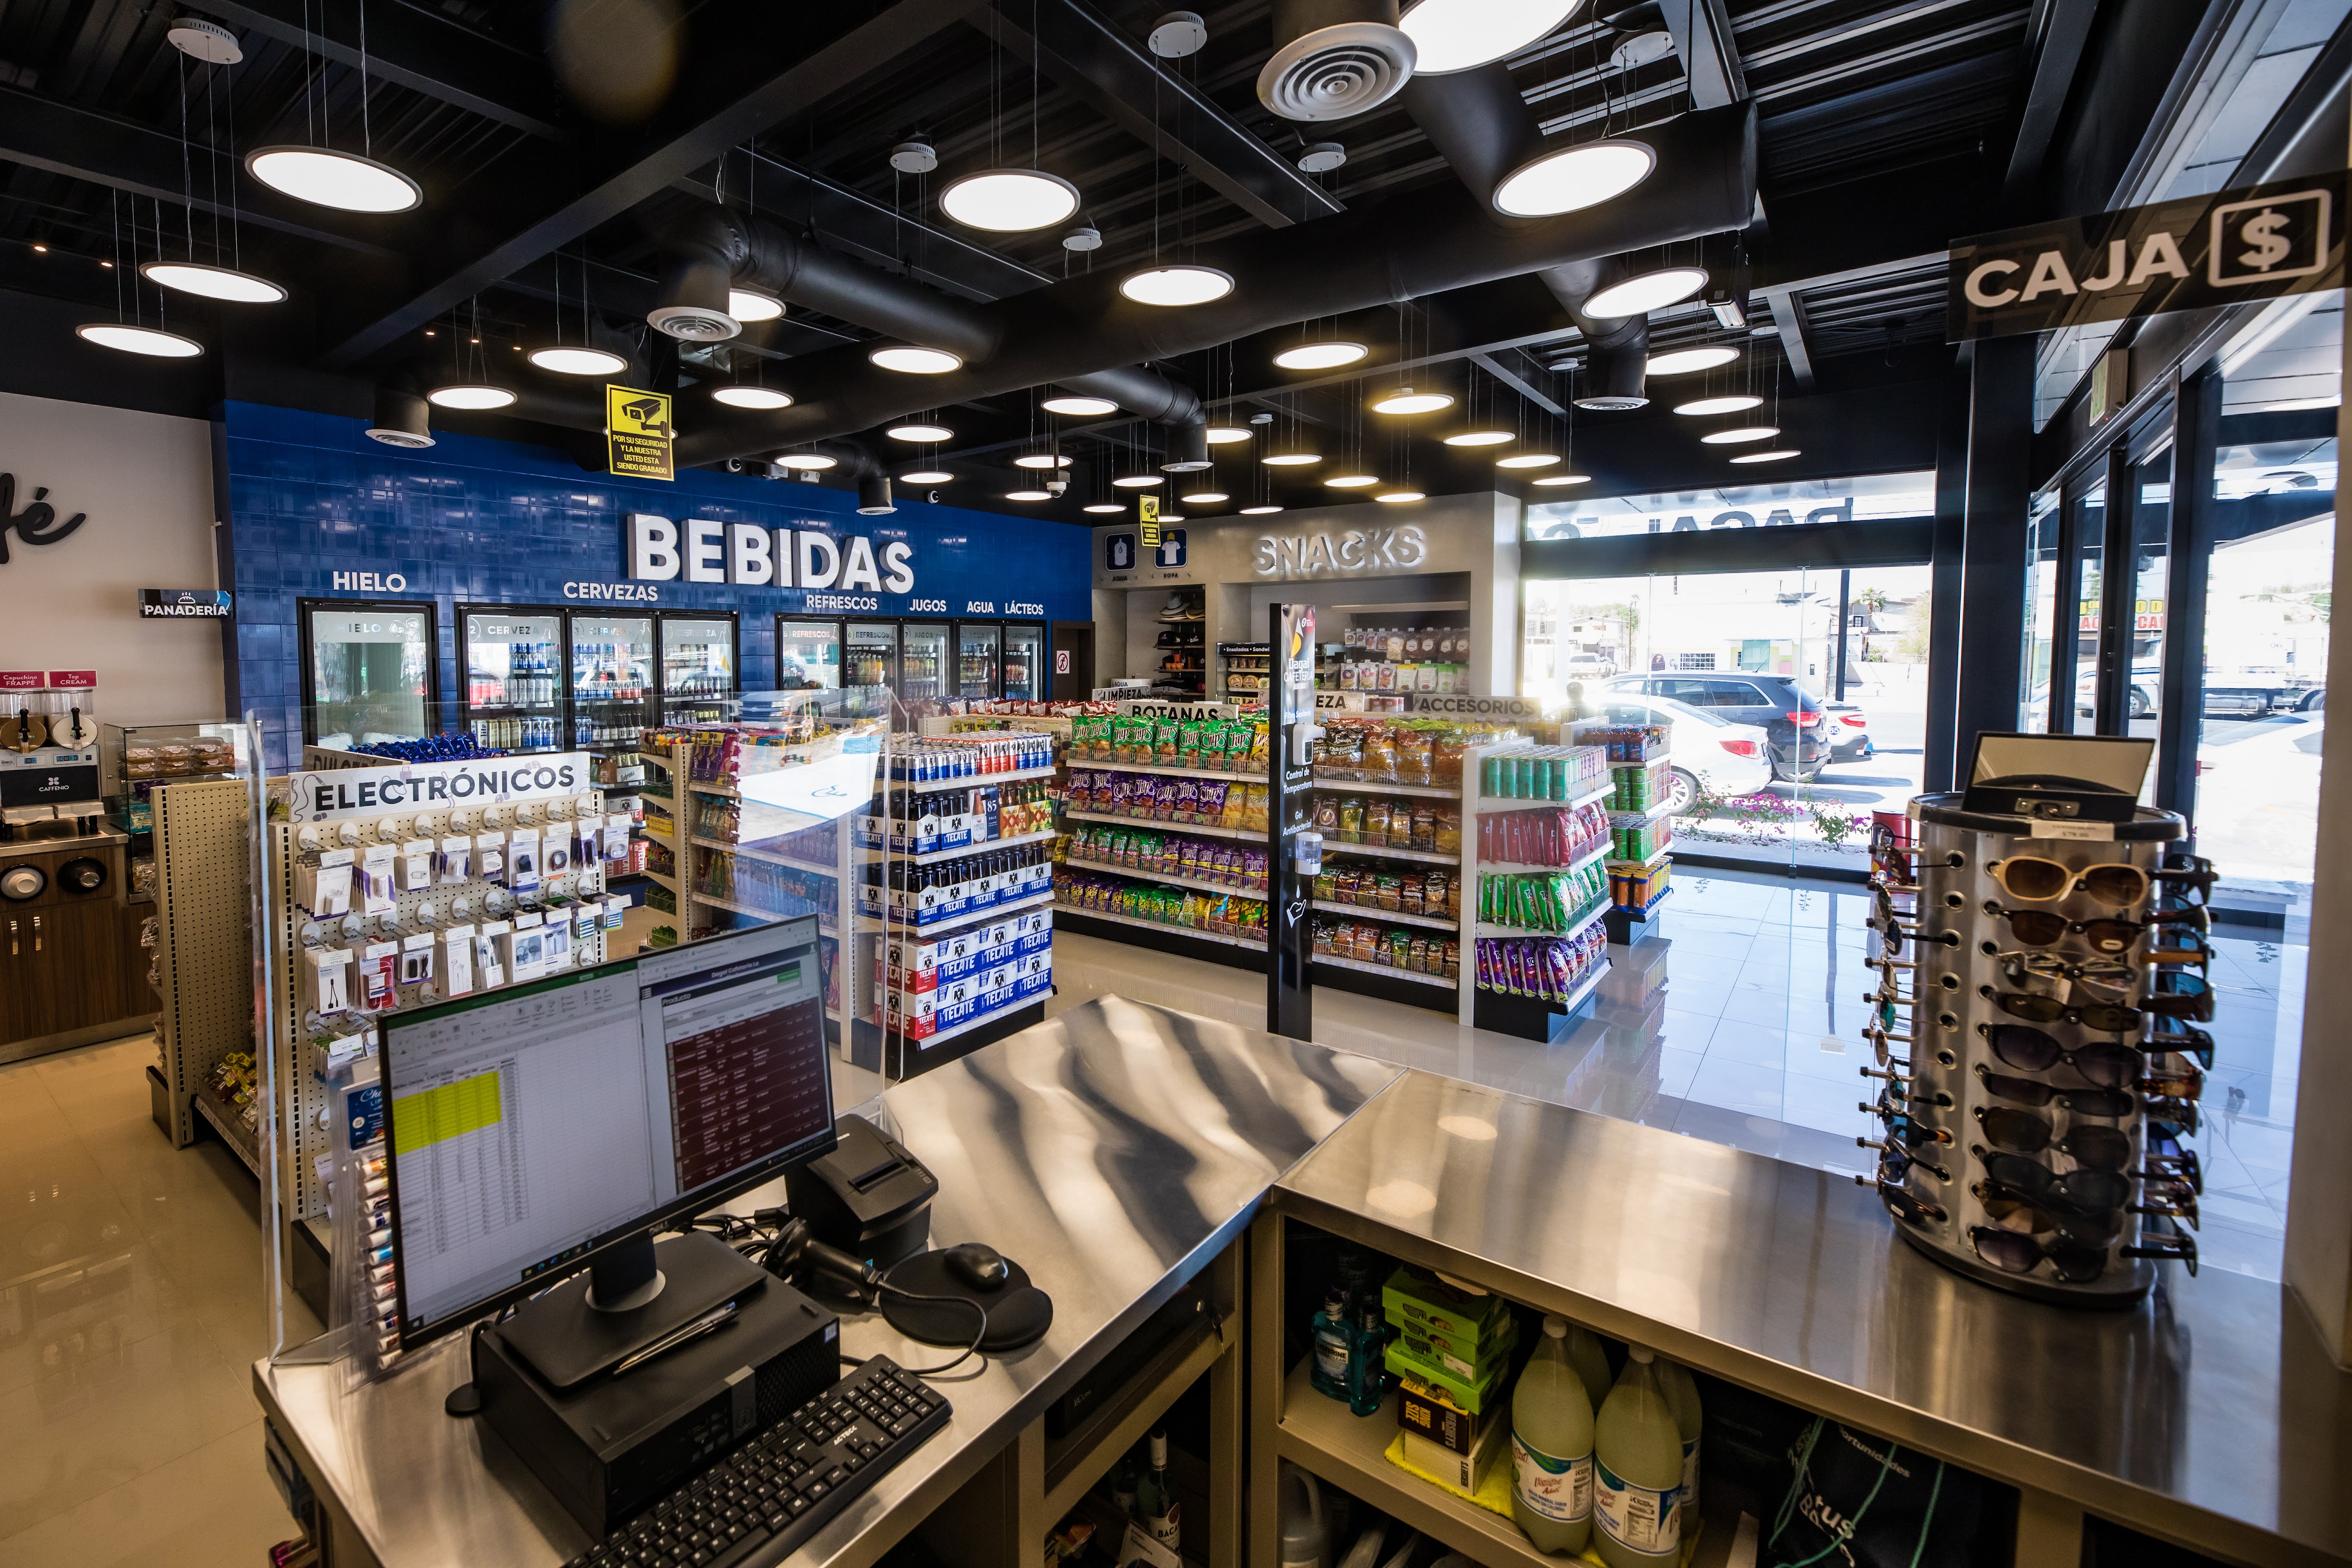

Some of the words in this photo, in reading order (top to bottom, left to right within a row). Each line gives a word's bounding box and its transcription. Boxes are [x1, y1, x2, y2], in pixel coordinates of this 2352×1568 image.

[1965, 232, 2190, 308] CAJA
[635, 438, 667, 448] SEGURIDAD
[624, 454, 644, 462] USTED
[634, 447, 662, 456] NUESTRA
[617, 462, 639, 471] SIENDO
[639, 465, 667, 474] GRABADO
[628, 514, 914, 594] BEBIDAS
[1253, 526, 1425, 572] SNACKS
[333, 571, 406, 592] HIELO
[564, 582, 658, 601] CERVEZAS
[806, 594, 877, 610] REFRESCOS
[909, 599, 947, 612] JUGOS
[966, 601, 994, 614] AGUA
[1005, 600, 1044, 615] LÁCTEOS
[145, 602, 228, 617] PANADERÍA
[470, 625, 476, 635] 2
[488, 626, 539, 635] CERVEZA
[1288, 657, 1310, 671] Dagal
[1284, 669, 1313, 682] CAFETERÍA
[1103, 689, 1142, 701] LIMPIEZA
[1420, 697, 1537, 715] ACCESORIOS
[1132, 705, 1218, 721] BOTANAS
[1286, 710, 1295, 720] Filtro
[1296, 709, 1312, 719] Sanitario
[1286, 768, 1303, 780] Control
[1304, 767, 1310, 776] de
[315, 765, 574, 812] ELECTRÓNICOS
[1284, 779, 1312, 795] Temperatura
[987, 800, 996, 812] 85
[1295, 809, 1303, 820] Gel
[1283, 819, 1312, 837] Antibacterial
[861, 832, 882, 843] TECATE
[920, 836, 937, 845] TECATE
[946, 830, 968, 843] TECATE
[1030, 877, 1049, 890] TECATE
[1005, 884, 1023, 897] TECATE
[1071, 888, 1083, 897] Takis
[975, 891, 998, 905] TECATE
[1123, 897, 1135, 907] Takis
[922, 906, 937, 917] TECATE
[944, 898, 967, 913] TECATE
[1166, 906, 1180, 916] Takis
[1183, 904, 1194, 913] Taki
[1023, 929, 1050, 949] TECATE
[984, 941, 1015, 963] TECATE
[942, 955, 976, 977] TECATE
[919, 968, 937, 978] TECATE
[1022, 970, 1049, 991] TECATE
[663, 993, 691, 1004] Producto
[984, 983, 1015, 1006] TECATE
[942, 998, 976, 1022] TECATE
[918, 1014, 935, 1024] TECATE
[1406, 1401, 1419, 1423] SIZE
[1419, 1406, 1431, 1428] KING
[1446, 1411, 1457, 1449] HERSHEY'S
